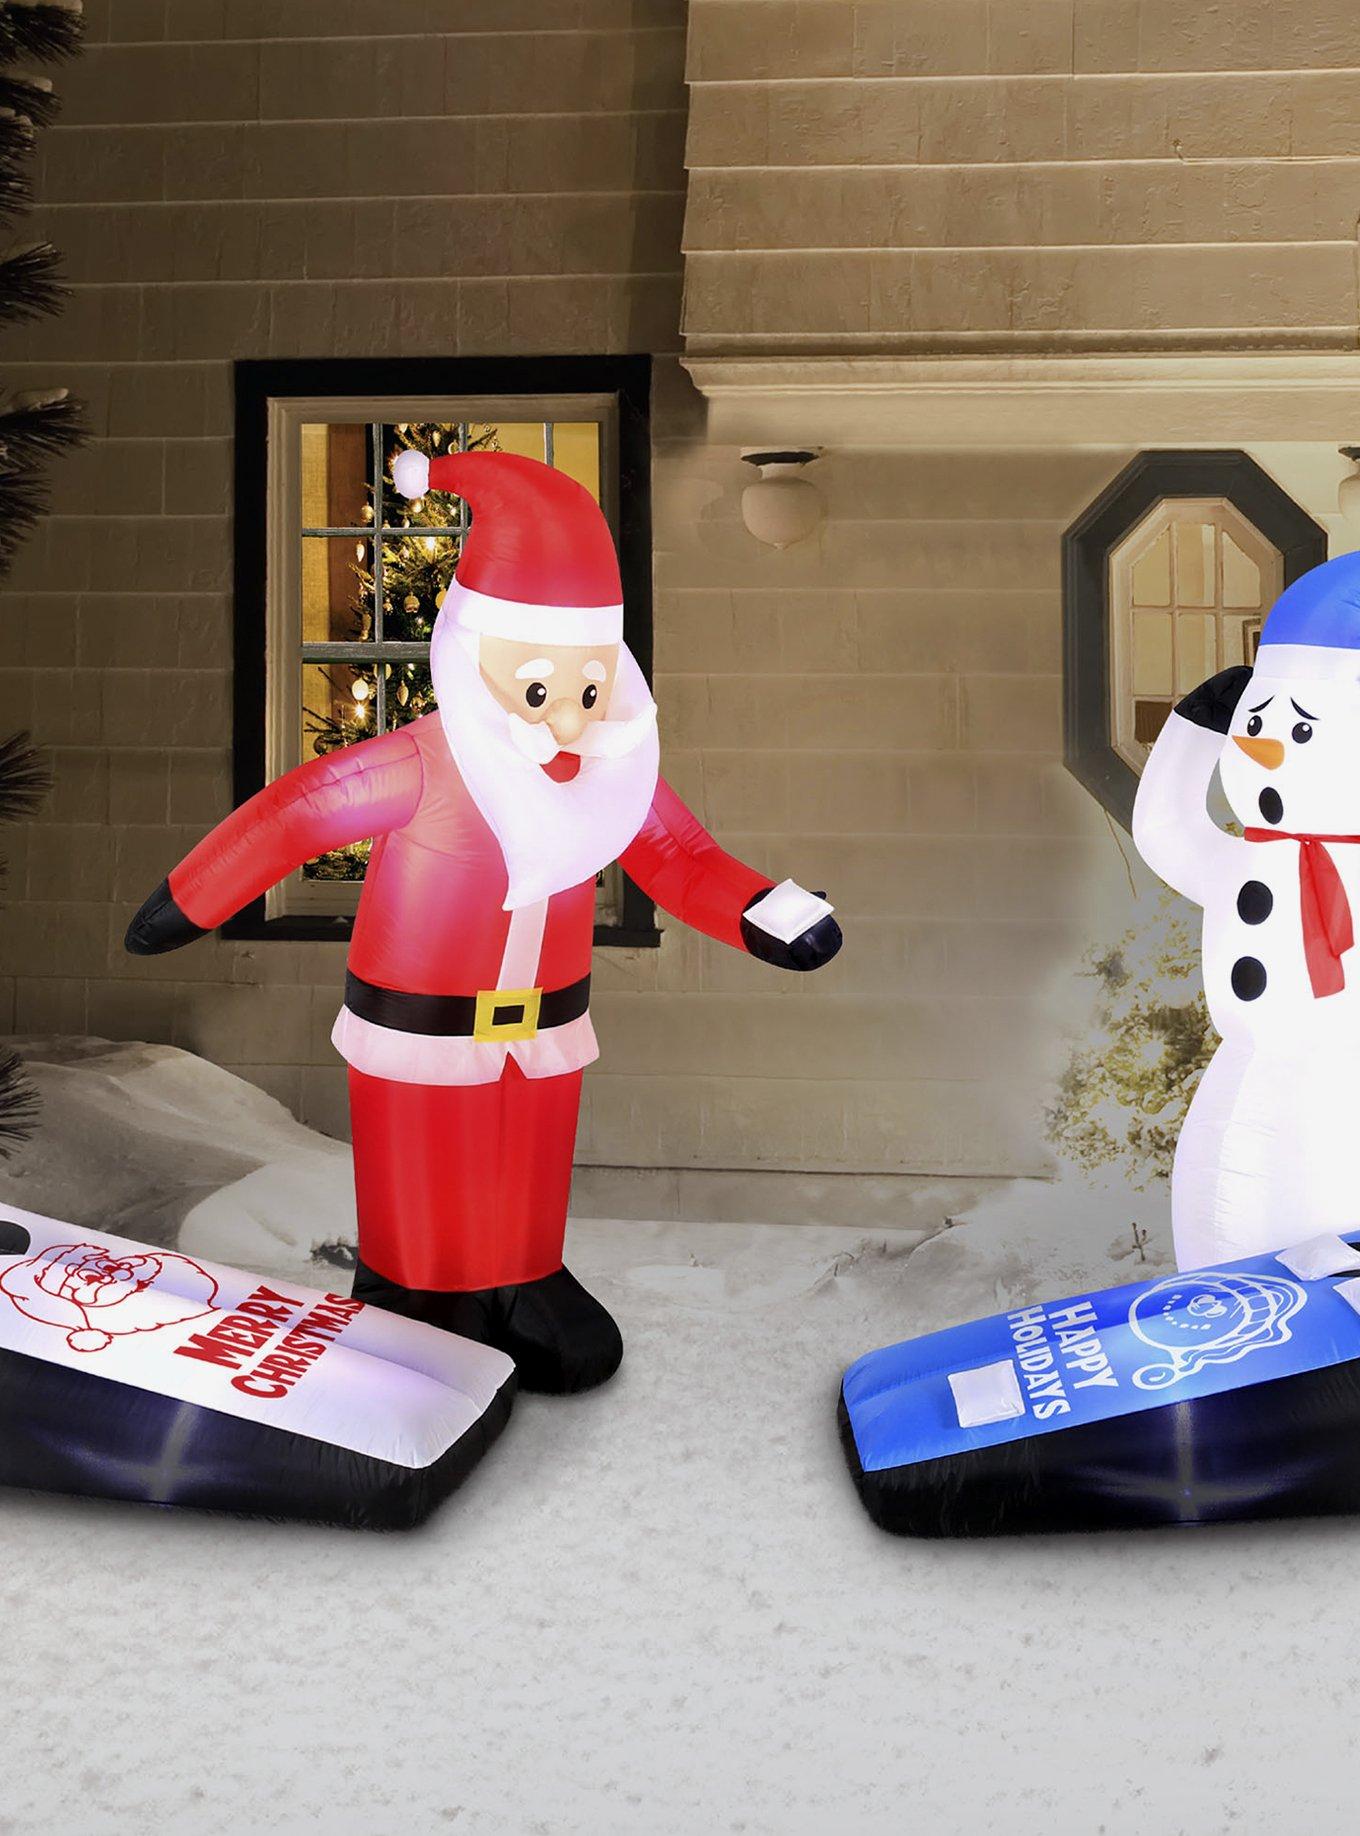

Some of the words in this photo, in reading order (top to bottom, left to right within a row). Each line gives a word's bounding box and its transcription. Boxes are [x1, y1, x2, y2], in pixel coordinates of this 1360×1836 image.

[174, 1285, 304, 1370] MERRY
[231, 1293, 366, 1398] CHRISTMAS
[1007, 1305, 1071, 1420] HOLIDAYS
[1046, 1301, 1119, 1391] HAPPY
